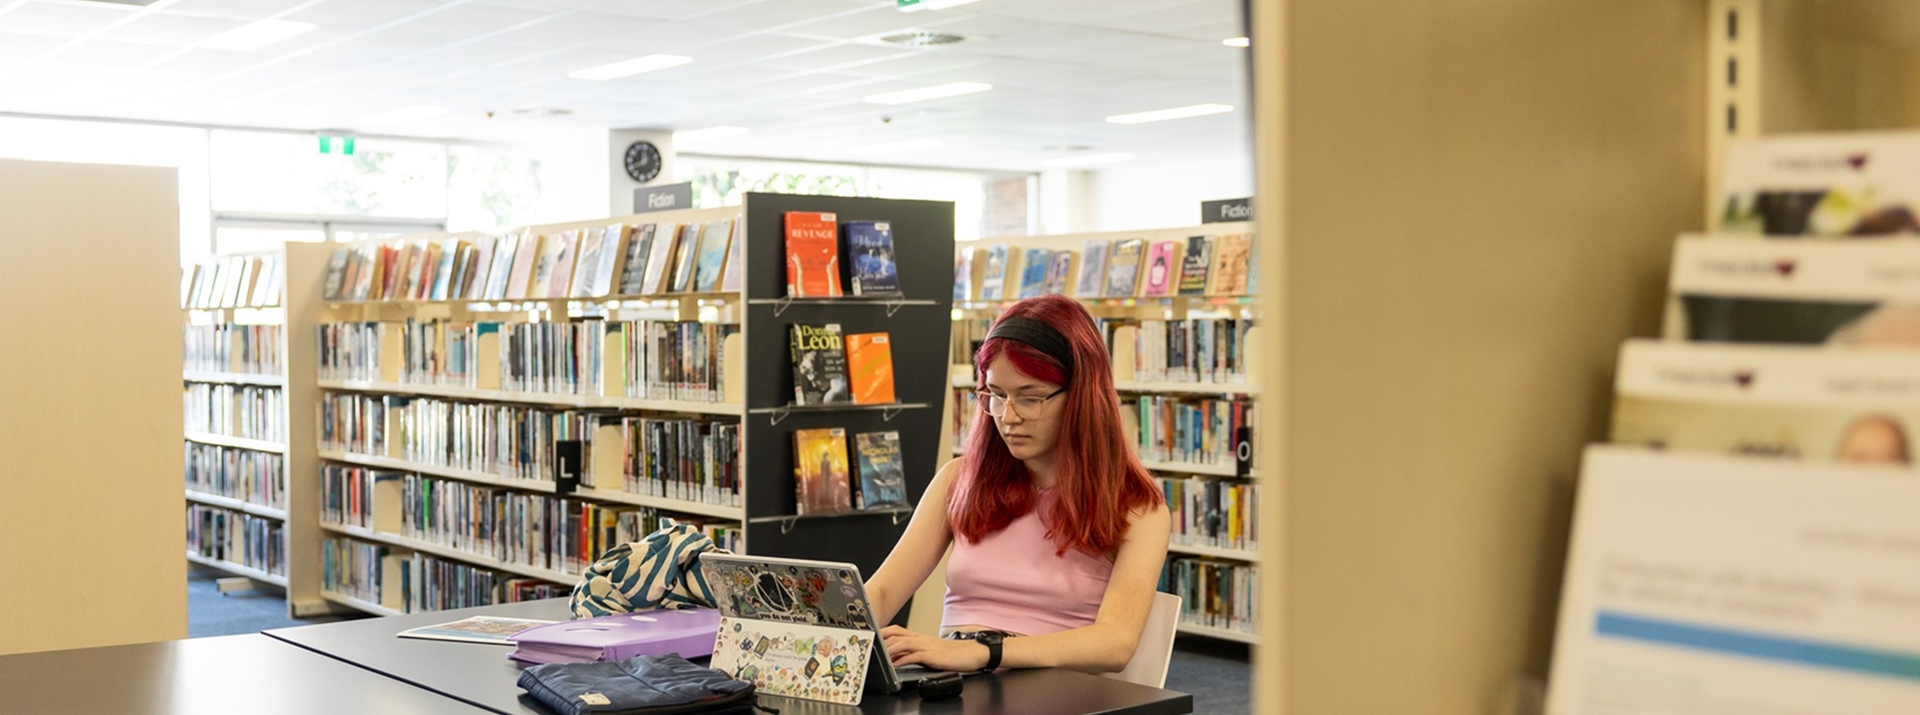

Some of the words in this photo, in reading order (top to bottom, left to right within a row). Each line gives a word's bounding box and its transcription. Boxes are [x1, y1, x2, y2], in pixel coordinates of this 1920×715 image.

[649, 193, 675, 208] Fiction
[1221, 204, 1253, 219] Fiction
[791, 228, 834, 239] REVENGE
[798, 330, 842, 350] Leon
[560, 456, 574, 478] L
